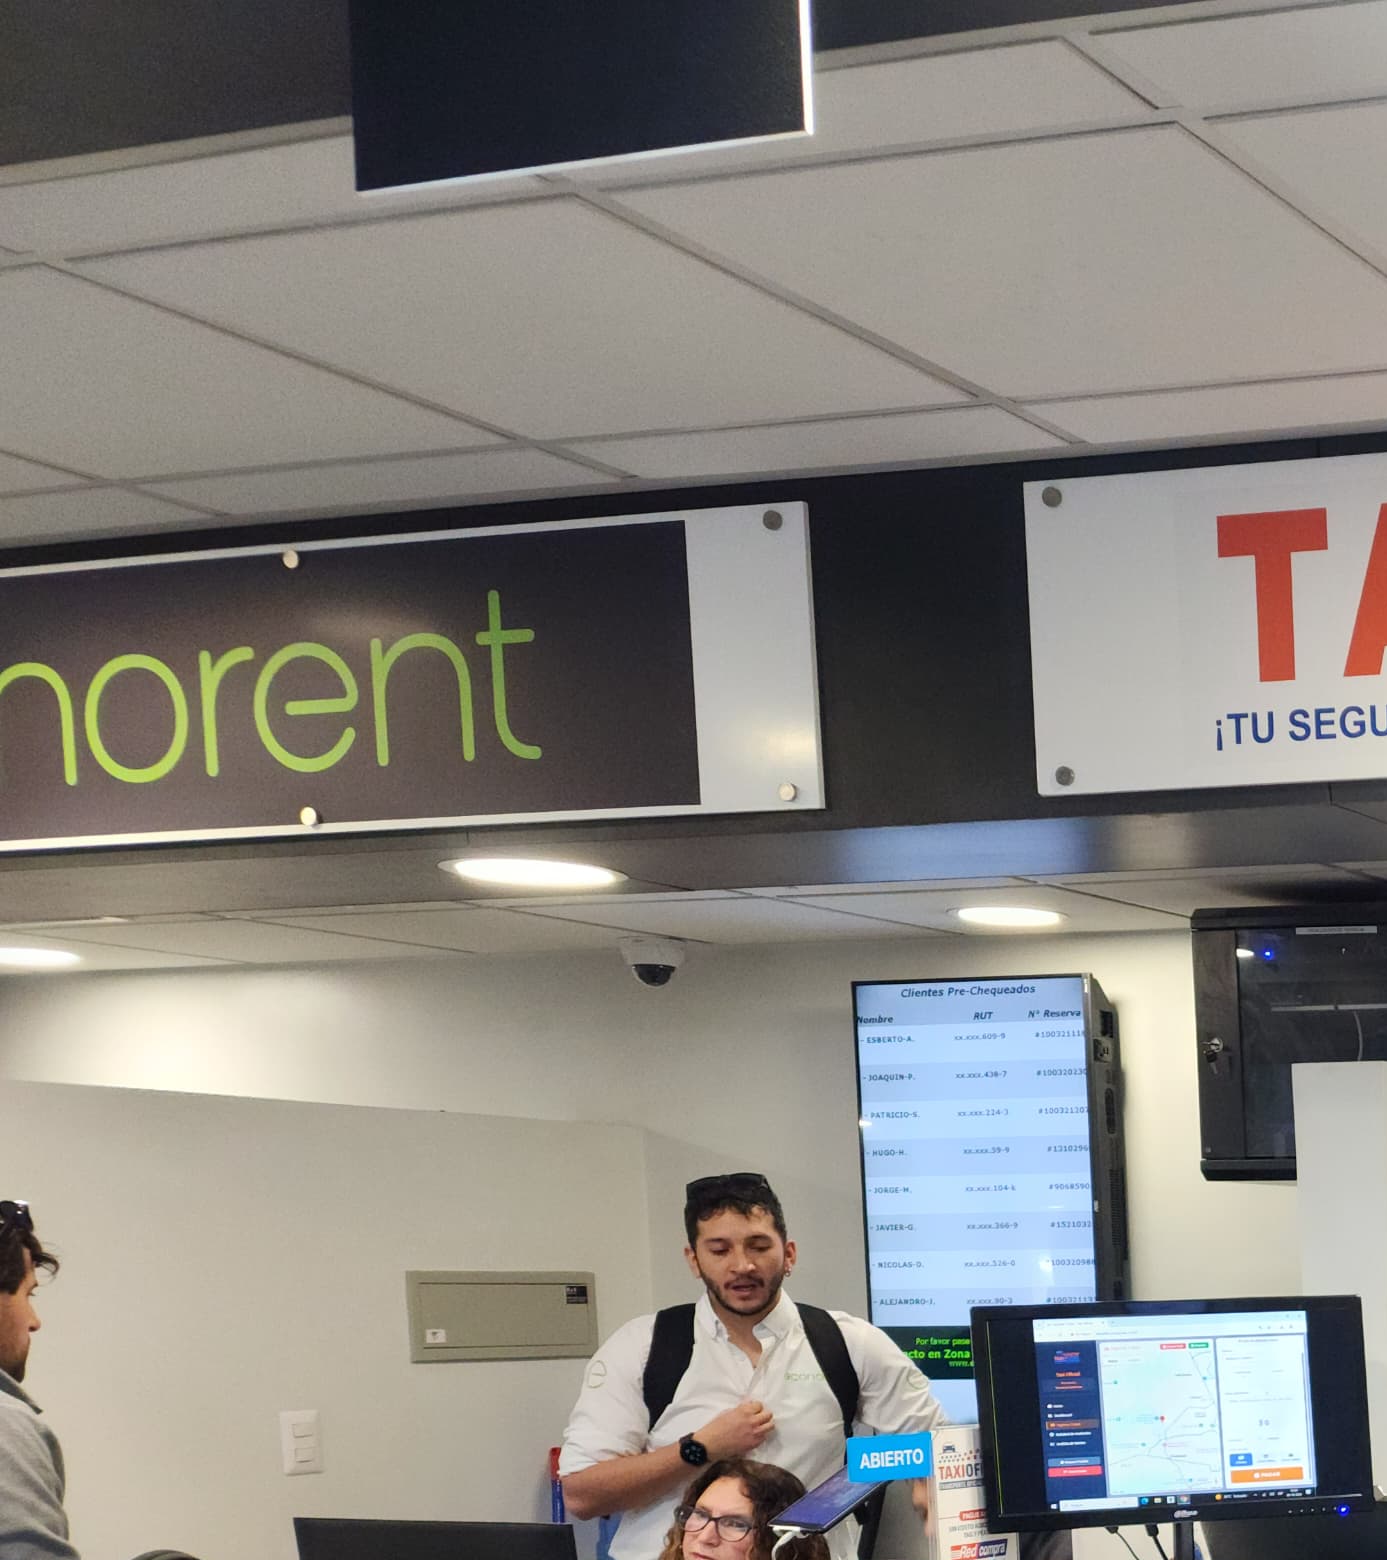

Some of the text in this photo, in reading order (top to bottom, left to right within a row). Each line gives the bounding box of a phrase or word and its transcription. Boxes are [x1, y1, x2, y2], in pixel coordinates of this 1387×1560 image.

[1214, 708, 1275, 751] ¡TU
[900, 984, 1036, 998] Clientes Pre-Chequeados
[856, 1014, 894, 1024] Nombre
[973, 1011, 993, 1021] RUT
[1043, 1009, 1081, 1018] Reserva
[928, 1351, 941, 1359] en
[943, 1349, 971, 1359] Zona
[859, 1448, 925, 1470] ABIERTO
